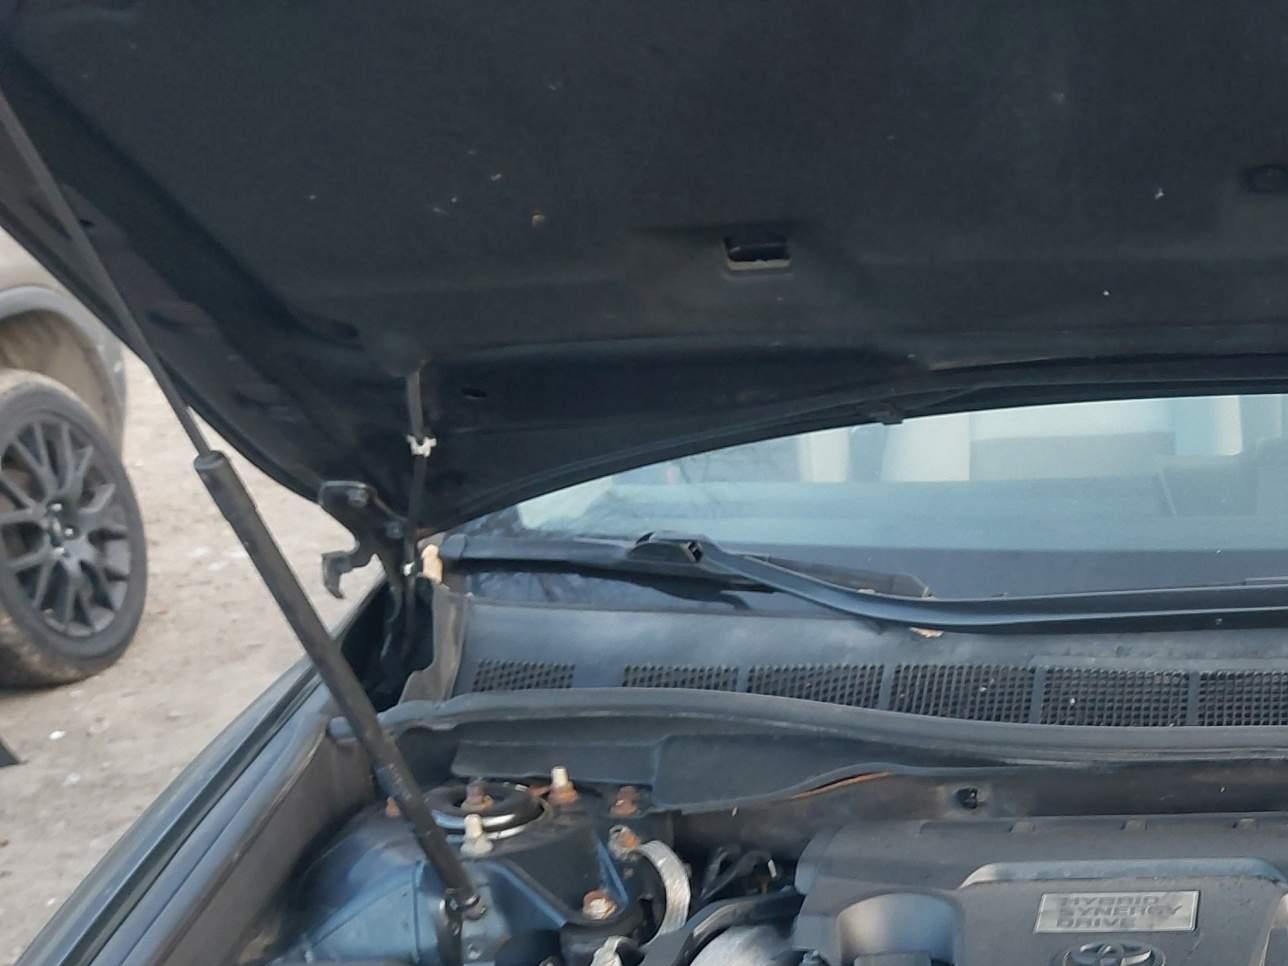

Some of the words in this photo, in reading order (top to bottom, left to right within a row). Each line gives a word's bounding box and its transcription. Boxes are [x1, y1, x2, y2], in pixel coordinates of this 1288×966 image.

[1060, 896, 1160, 906] HYBRID
[1059, 905, 1183, 918] SYNERGY
[1056, 917, 1137, 929] DRIVE
